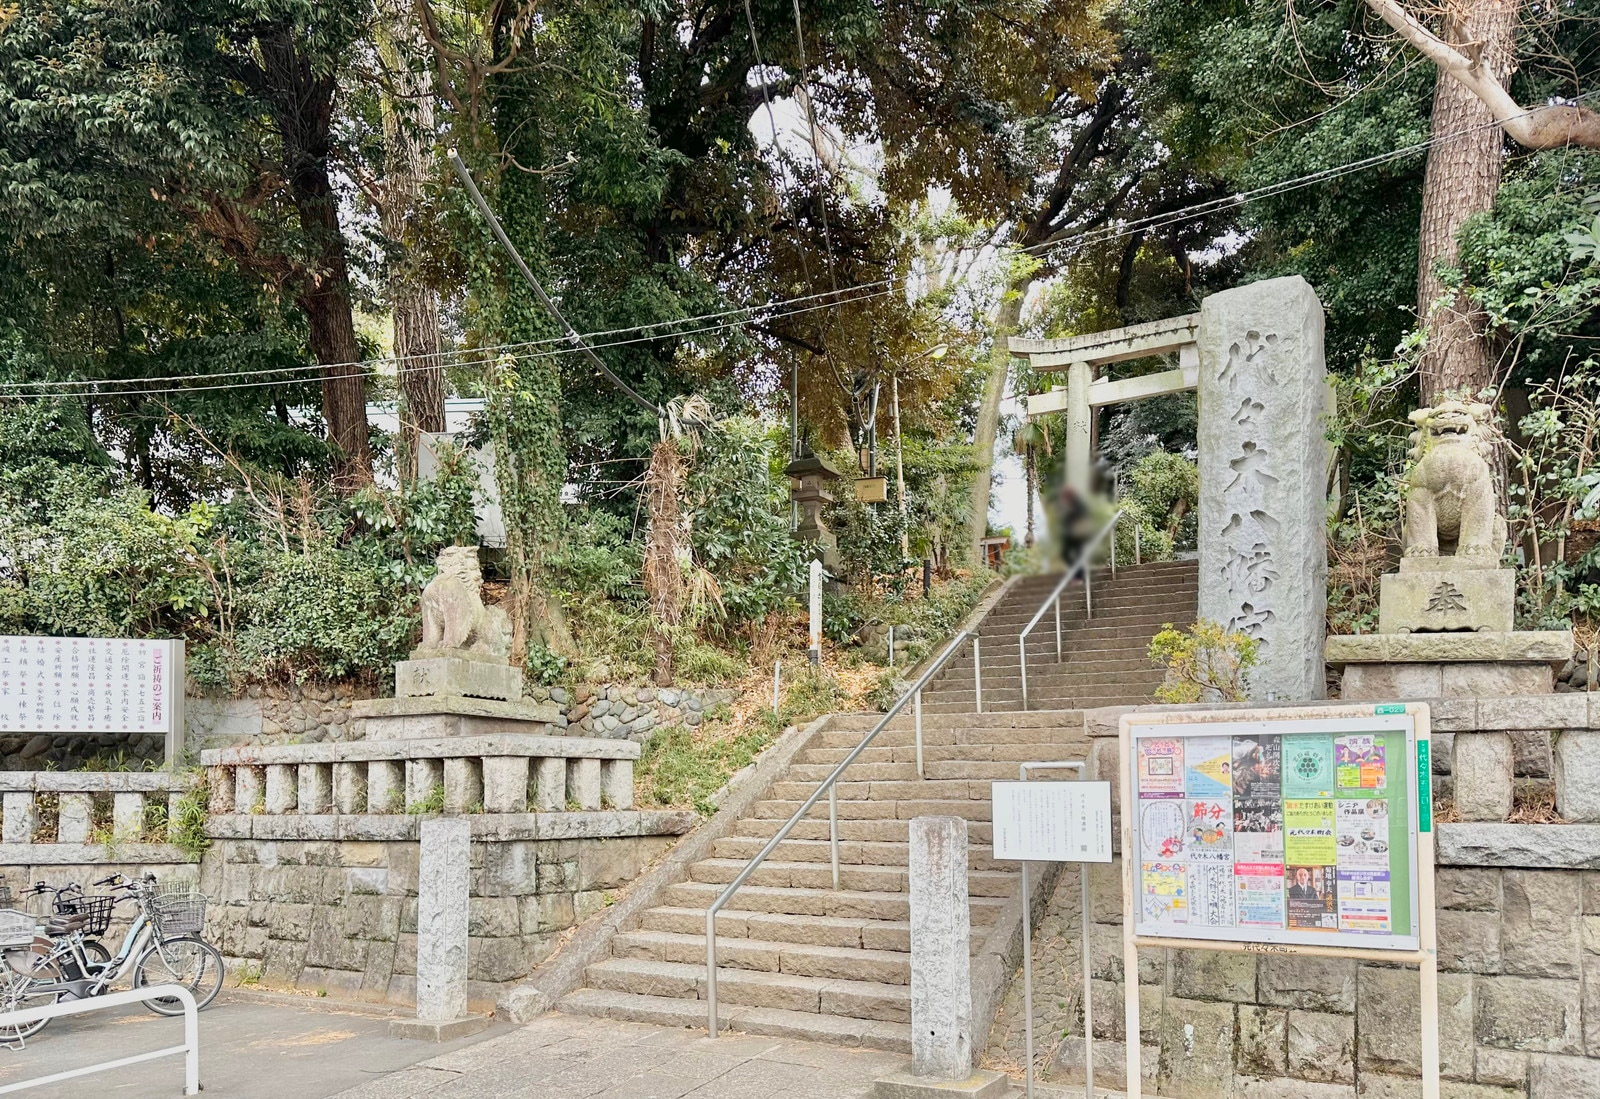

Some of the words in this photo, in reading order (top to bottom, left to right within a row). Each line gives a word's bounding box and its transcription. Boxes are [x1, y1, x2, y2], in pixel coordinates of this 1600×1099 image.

[1425, 581, 1467, 616] 奉
[71, 647, 80, 679] 合格祈願
[105, 648, 113, 680] 交通安全
[121, 648, 130, 680] 厄除開運
[152, 655, 162, 720] ご祈祷のご案内
[121, 689, 129, 721] 家内安全
[1193, 802, 1226, 820] 節分
[1190, 853, 1230, 861] 代々木八幡宮
